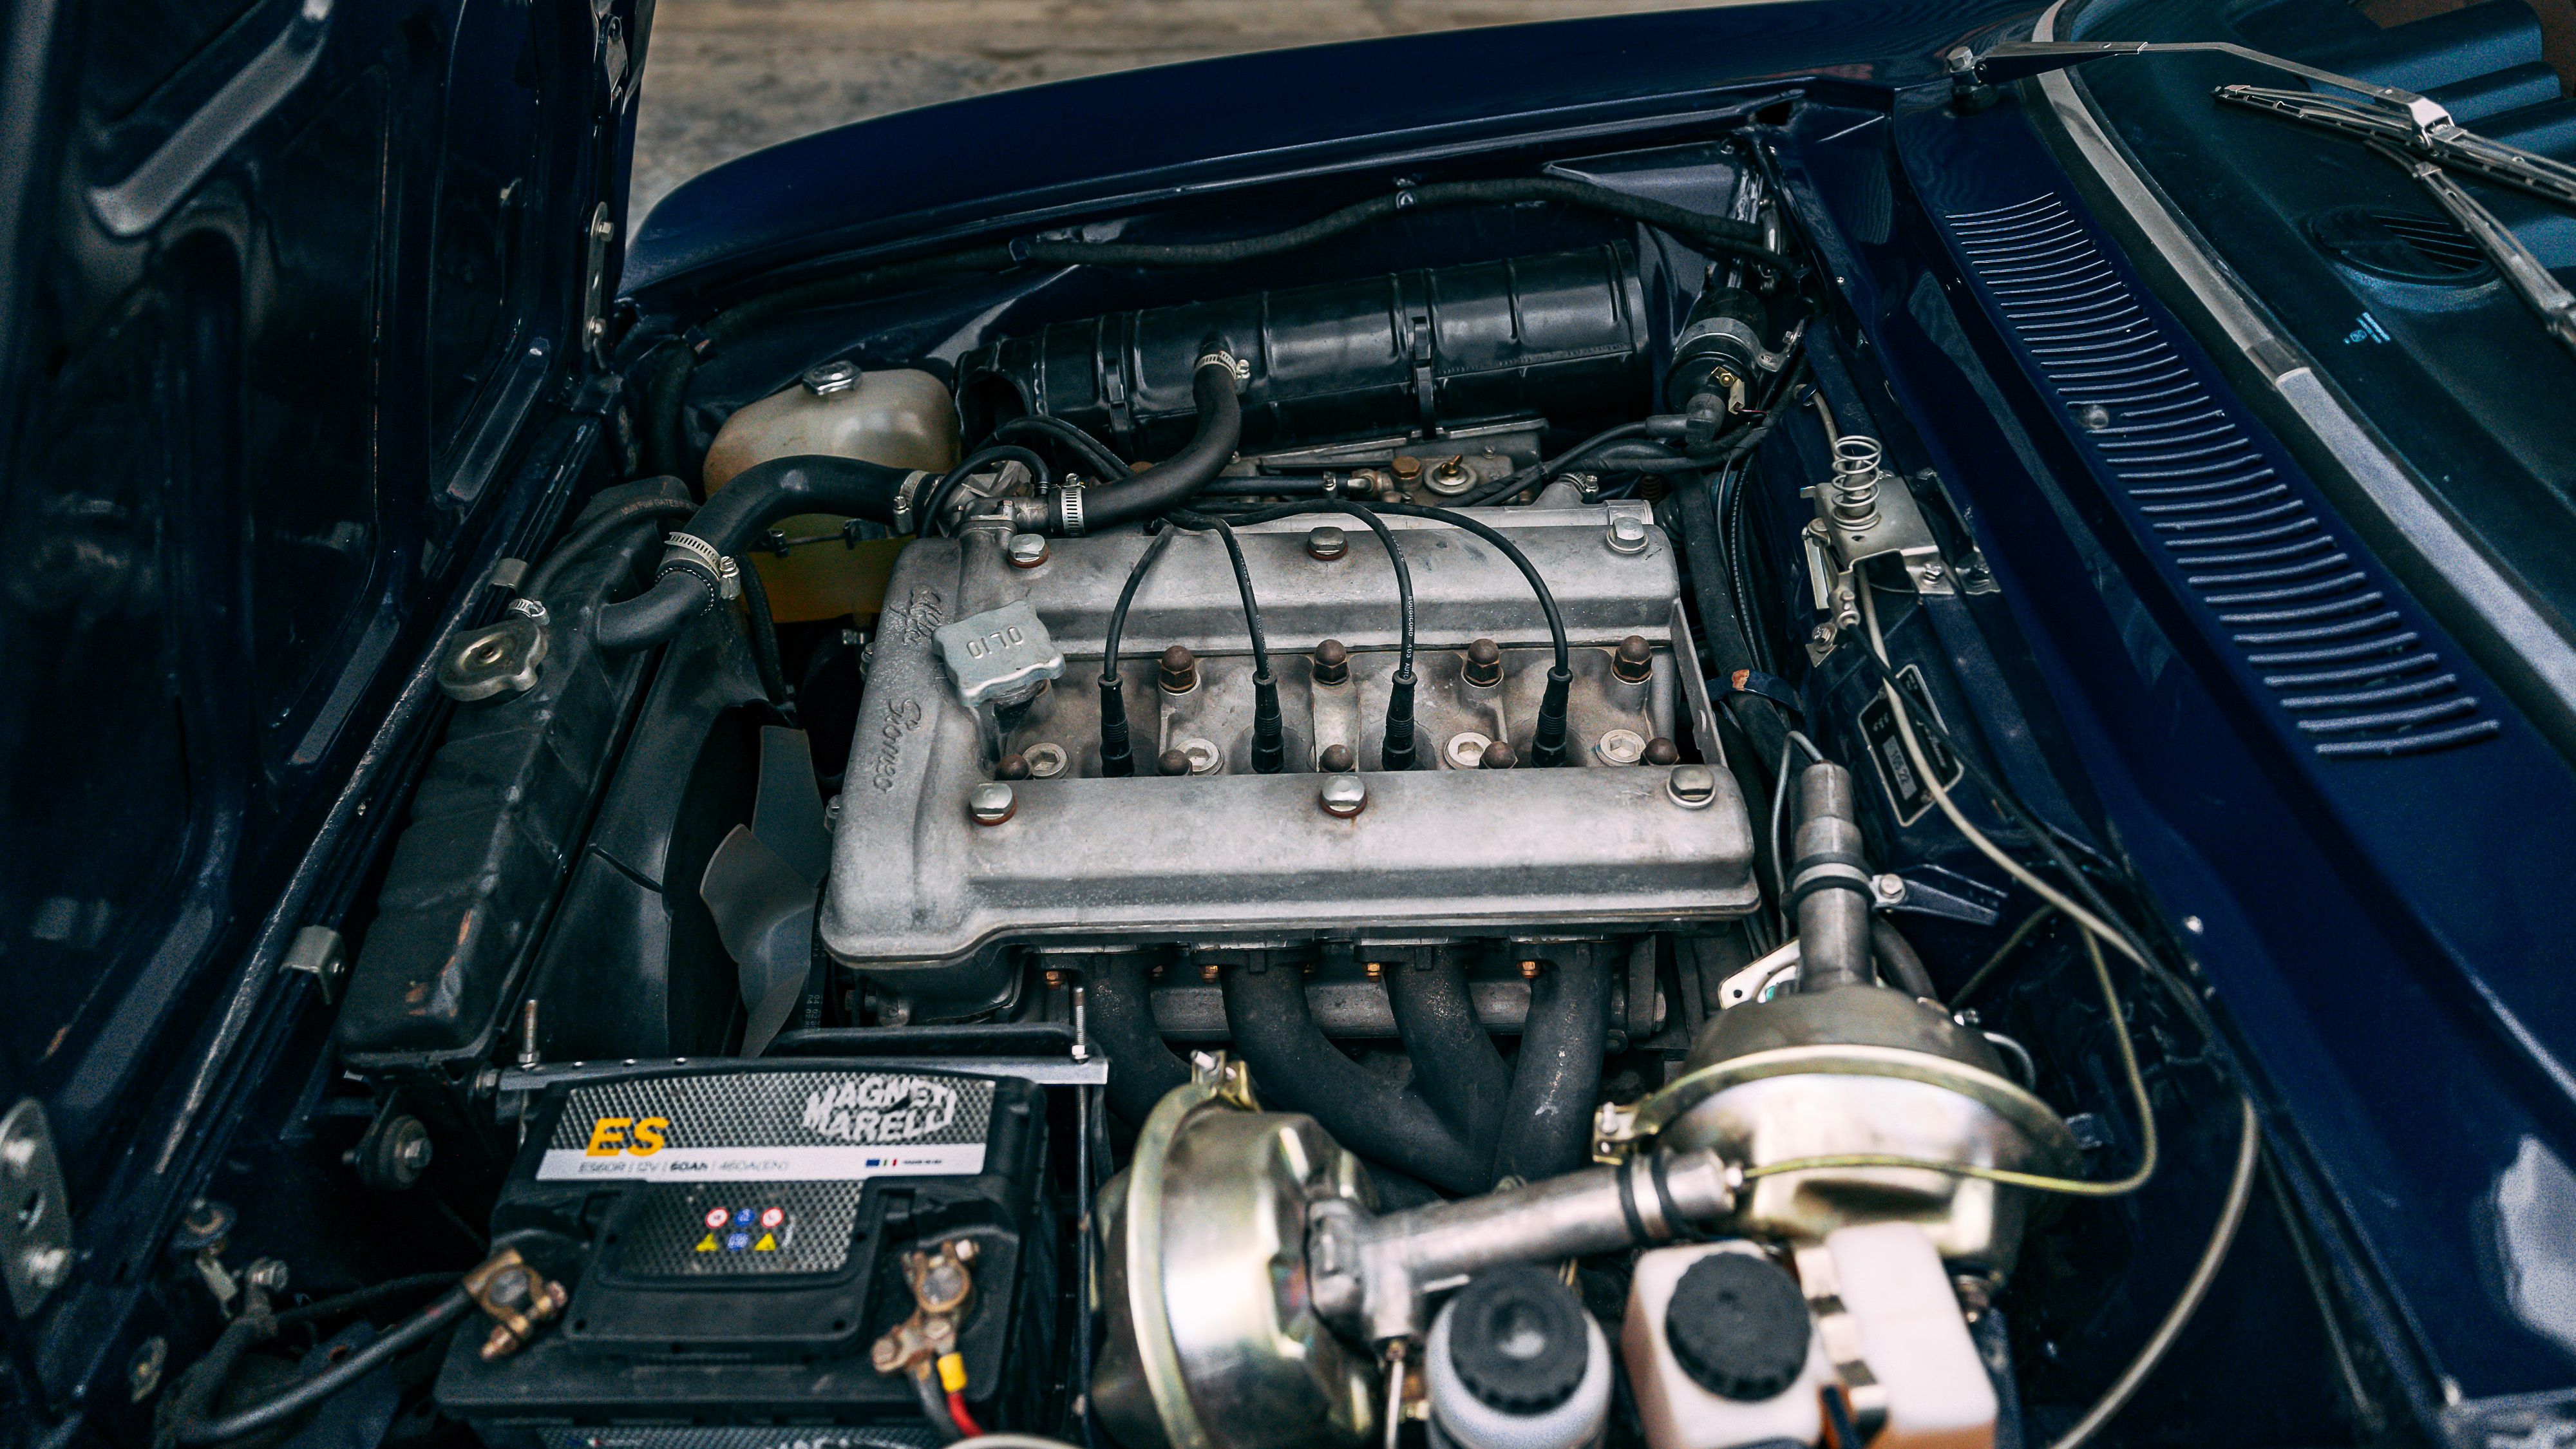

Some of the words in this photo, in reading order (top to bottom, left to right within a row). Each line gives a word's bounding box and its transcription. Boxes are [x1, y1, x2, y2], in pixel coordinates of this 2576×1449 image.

[967, 626, 1024, 659] OLIO
[873, 698, 922, 794] Romeo
[804, 1076, 958, 1121] MAGNETI
[585, 1116, 670, 1157] ES
[670, 1160, 708, 1173] 60Ah
